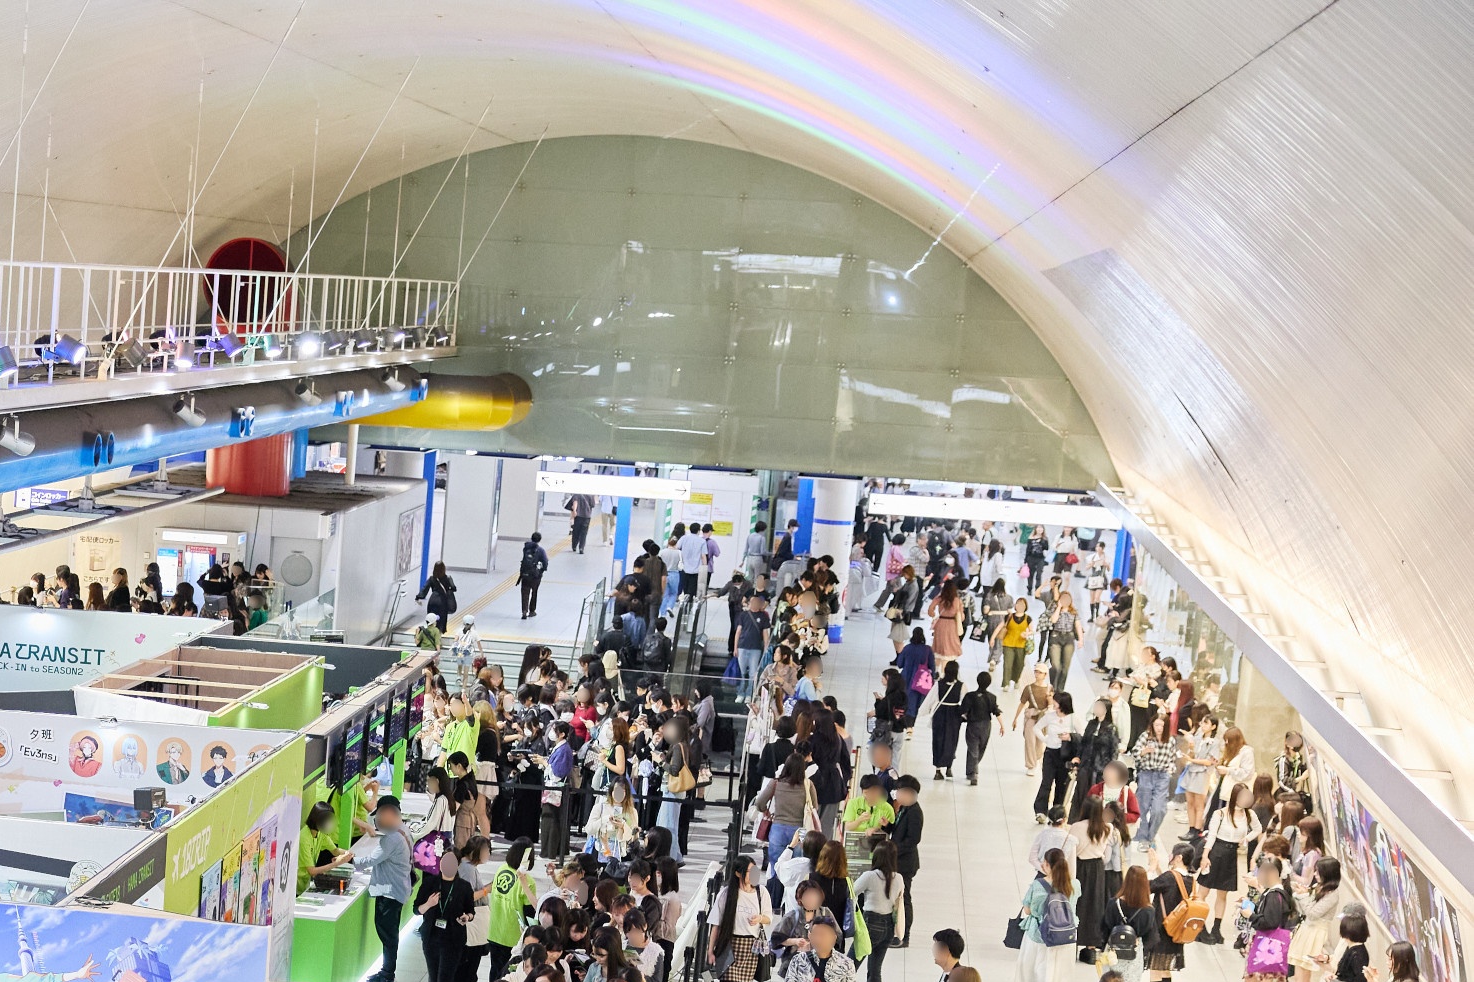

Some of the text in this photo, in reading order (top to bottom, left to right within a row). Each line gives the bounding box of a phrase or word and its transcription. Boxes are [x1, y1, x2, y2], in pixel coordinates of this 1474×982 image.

[79, 535, 120, 544] 宅配便ロッカー
[30, 663, 40, 673] to
[42, 665, 84, 676] SEASON2
